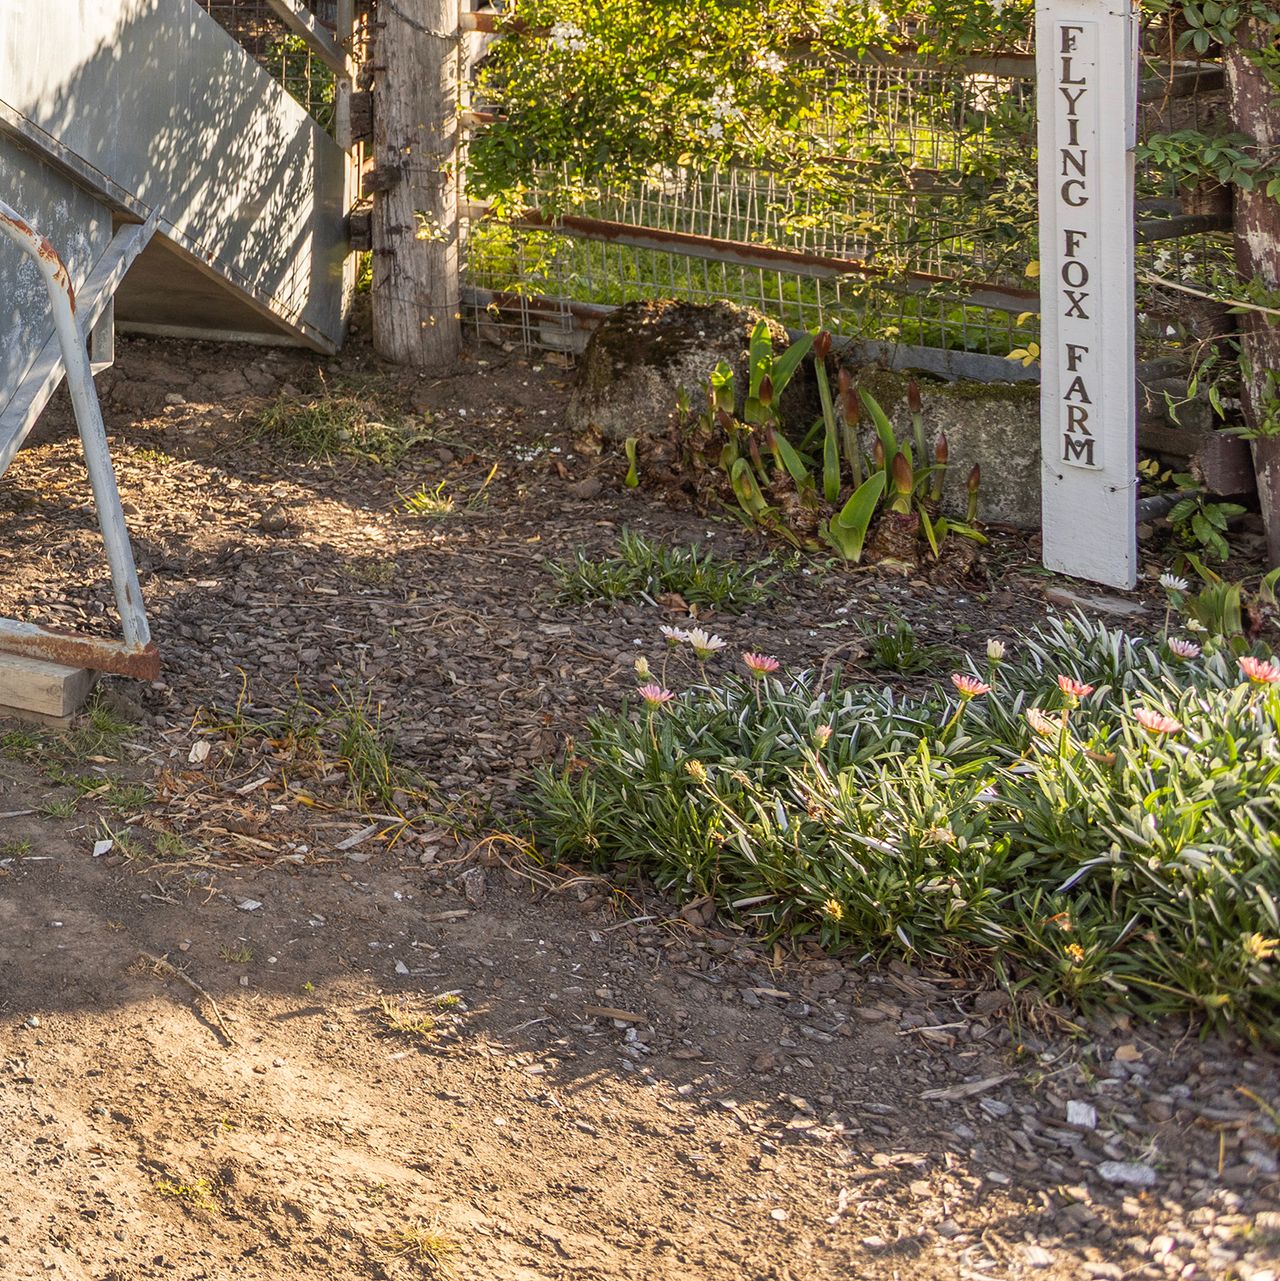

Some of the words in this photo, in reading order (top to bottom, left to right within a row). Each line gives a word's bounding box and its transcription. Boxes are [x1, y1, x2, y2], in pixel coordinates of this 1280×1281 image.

[1058, 25, 1089, 208] FLYING
[1062, 229, 1090, 320] FOX
[1062, 343, 1096, 467] FARM
